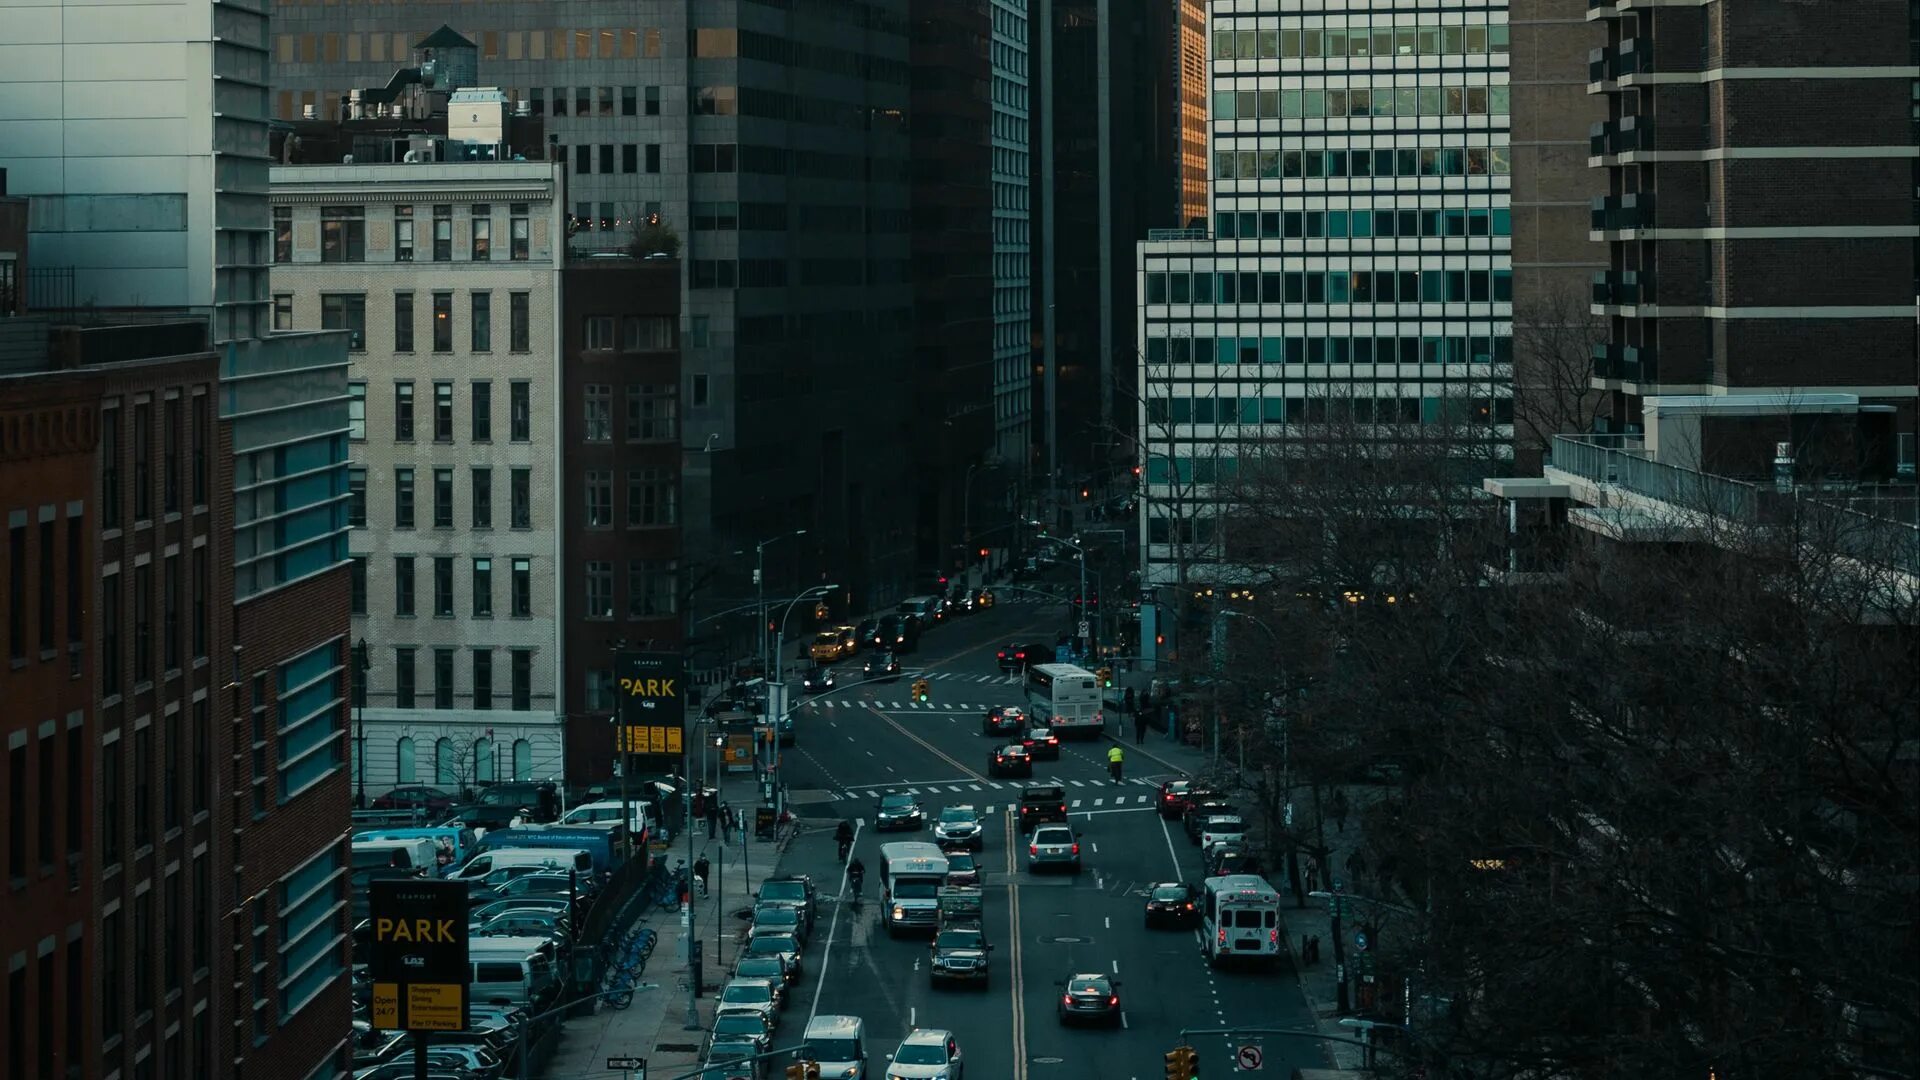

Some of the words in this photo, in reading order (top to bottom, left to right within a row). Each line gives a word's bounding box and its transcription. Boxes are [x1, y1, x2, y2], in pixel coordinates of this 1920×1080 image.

[377, 918, 456, 943] PARK
[375, 996, 397, 1006] Open
[376, 1007, 395, 1016] 24/7
